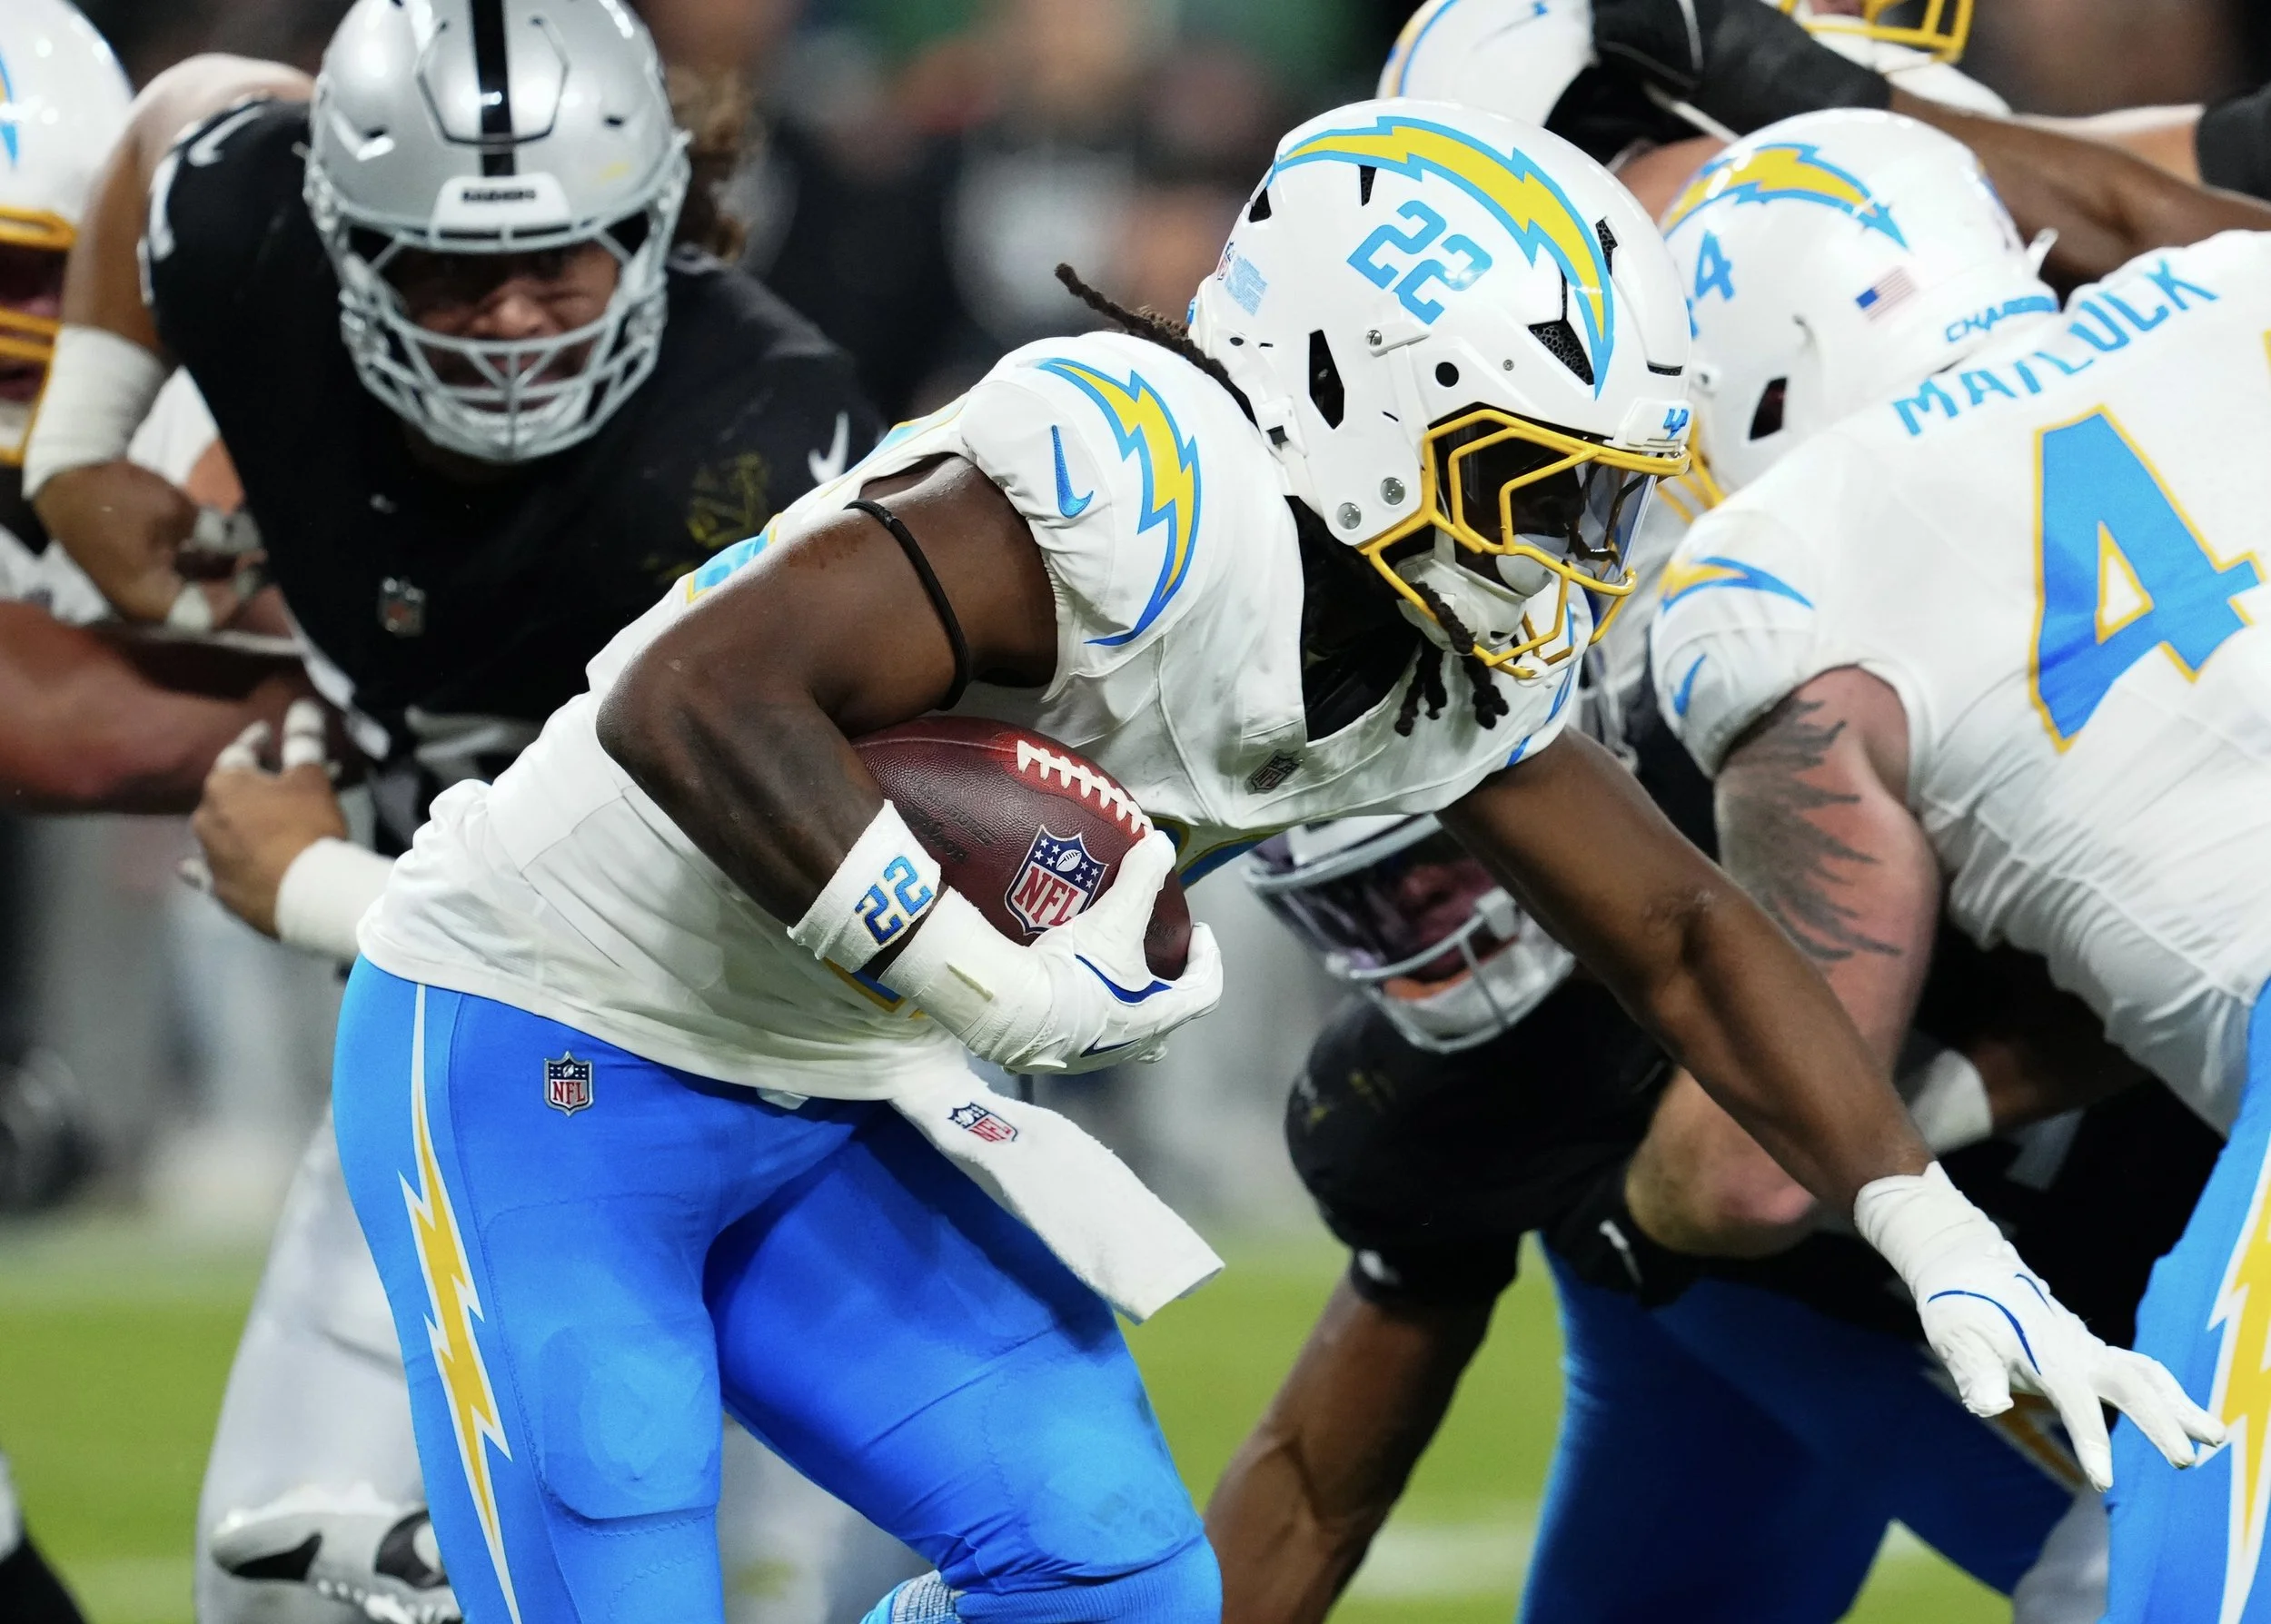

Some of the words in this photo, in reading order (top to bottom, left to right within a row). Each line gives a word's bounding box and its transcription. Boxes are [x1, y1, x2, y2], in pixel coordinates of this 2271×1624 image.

[1346, 200, 1493, 325] 22
[1686, 230, 1734, 340] 4
[2028, 327, 2271, 756] 4
[855, 856, 934, 945] 22
[1014, 866, 1079, 926] NFL
[552, 1081, 586, 1105] NFL
[968, 1117, 1012, 1142] NFL
